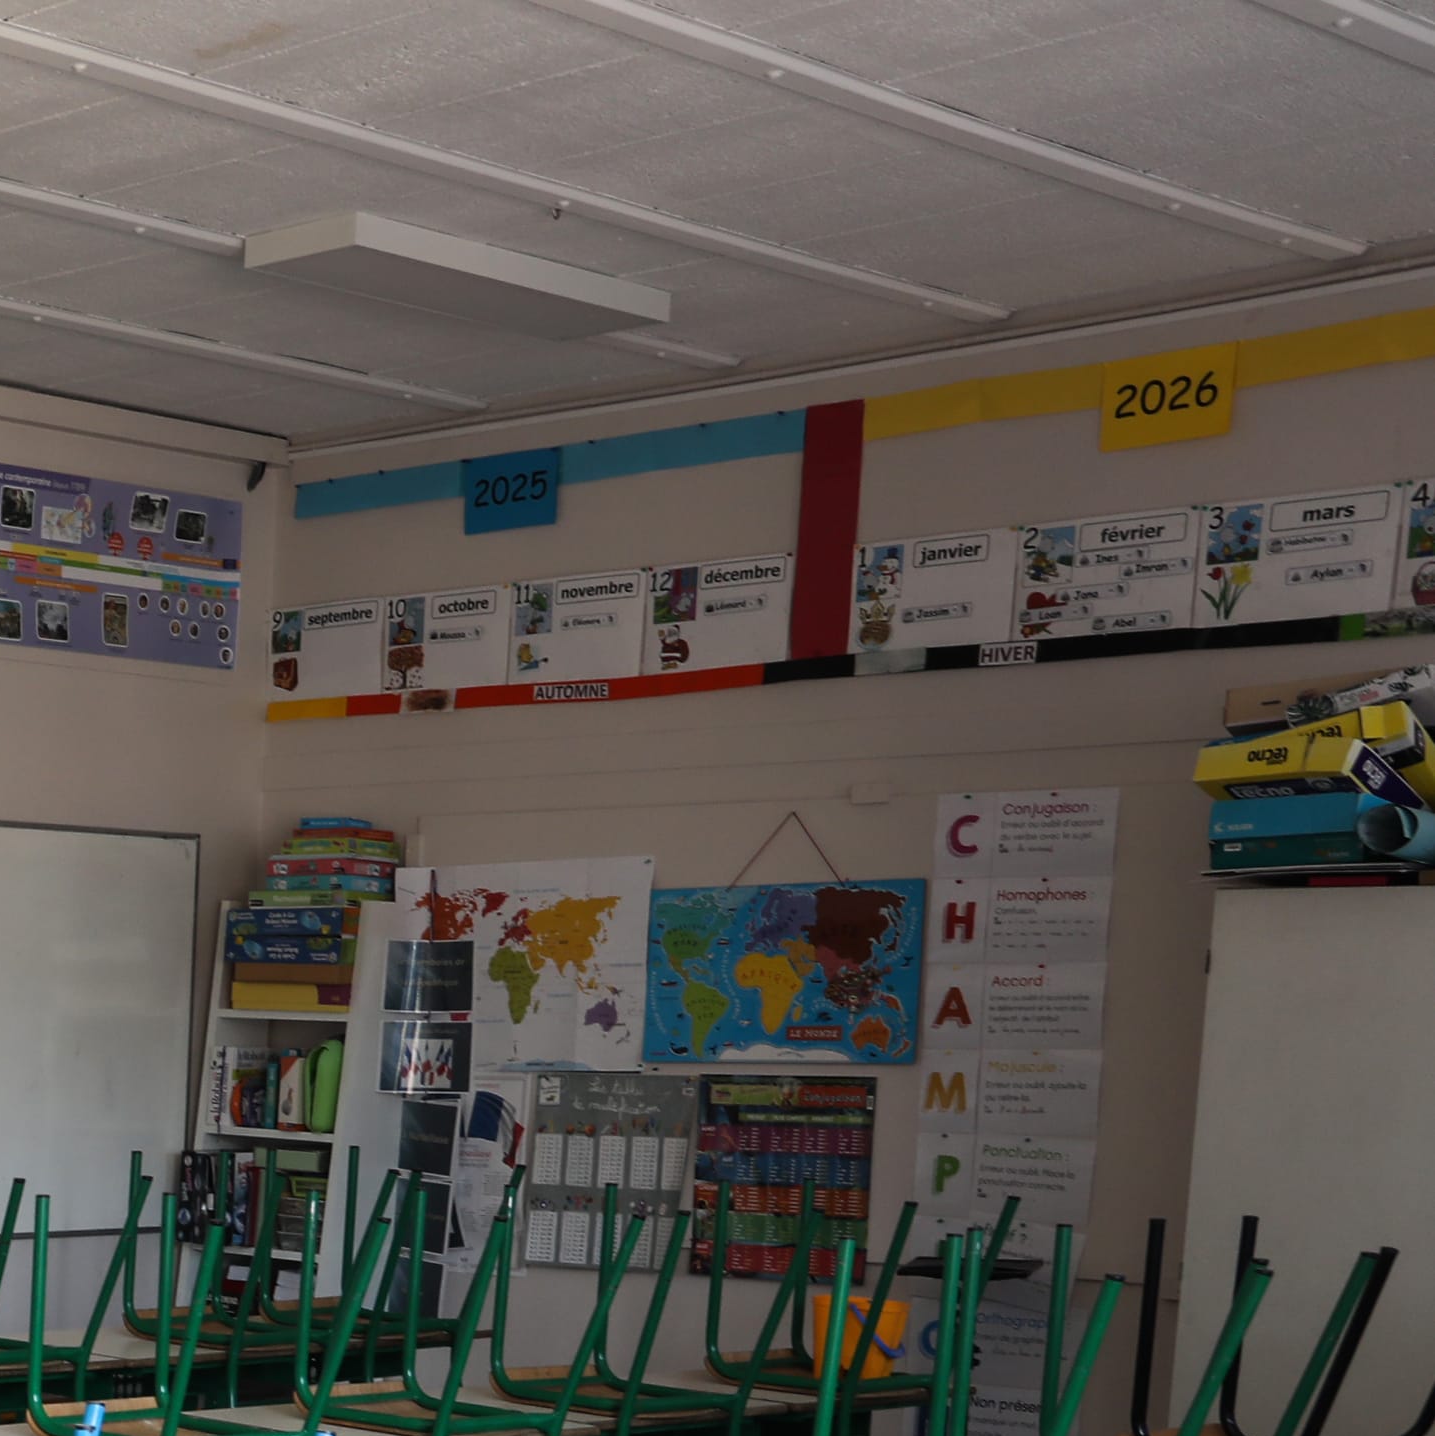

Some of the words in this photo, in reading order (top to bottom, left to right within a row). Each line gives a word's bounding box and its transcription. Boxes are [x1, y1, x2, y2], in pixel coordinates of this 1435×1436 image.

[1114, 371, 1219, 420] 2026
[474, 470, 548, 508] 2025
[1411, 482, 1430, 507] 4
[1209, 506, 1225, 530] 3
[1302, 503, 1355, 522] mars
[1023, 527, 1039, 549] 2
[1100, 524, 1165, 543] février
[857, 546, 867, 568] 1
[919, 543, 982, 565] janvier
[649, 571, 671, 593] 12
[704, 563, 782, 584] décembre
[514, 583, 530, 605] 11
[561, 580, 634, 599] novembre
[307, 607, 373, 627] septembre
[387, 599, 407, 620] 10
[438, 598, 490, 614] octobre
[272, 610, 283, 631] 9
[980, 645, 1035, 663] HIVER
[535, 685, 608, 700] AUTOMNE
[947, 814, 980, 855] C
[1002, 801, 1089, 818] Conjugaison
[945, 902, 976, 941] H
[997, 889, 1088, 904] Homophones
[934, 986, 972, 1029] A
[991, 974, 1044, 988] Accord
[925, 1071, 967, 1113] M
[934, 1154, 961, 1195] P
[983, 1144, 1063, 1161] Ponctuation
